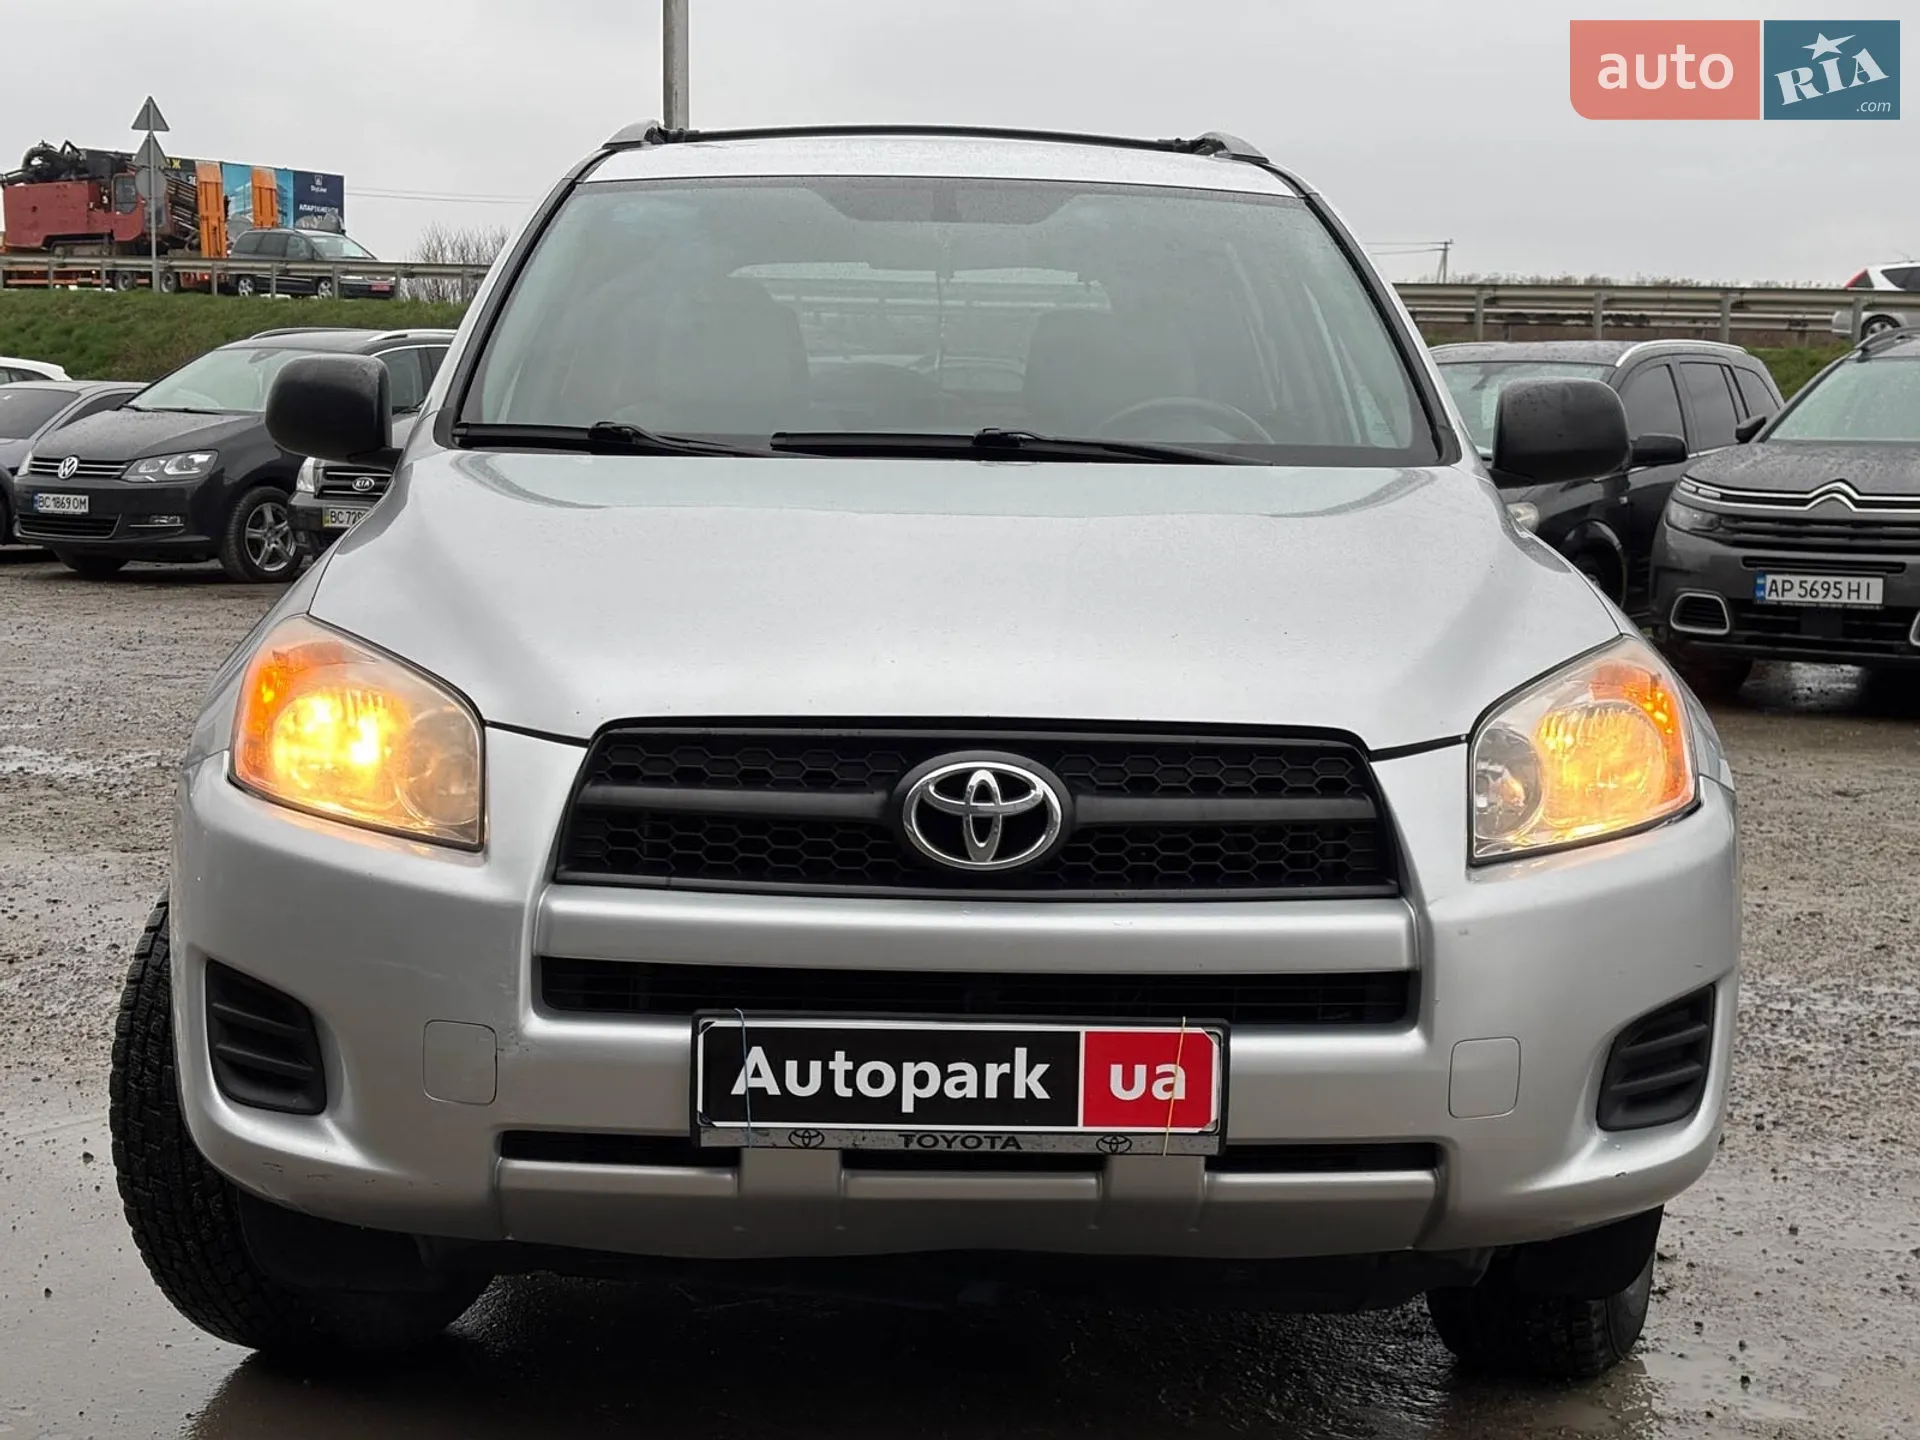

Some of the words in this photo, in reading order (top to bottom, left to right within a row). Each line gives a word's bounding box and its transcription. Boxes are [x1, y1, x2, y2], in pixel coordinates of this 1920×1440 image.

[38, 496, 51, 509] BC
[72, 497, 87, 510] OM
[330, 510, 344, 524] BC
[1768, 579, 1794, 598] AP
[1797, 580, 1844, 600] 5695
[731, 1046, 1051, 1114] Autopark
[1110, 1063, 1187, 1101] ua
[898, 1133, 1023, 1150] TOYOTA
